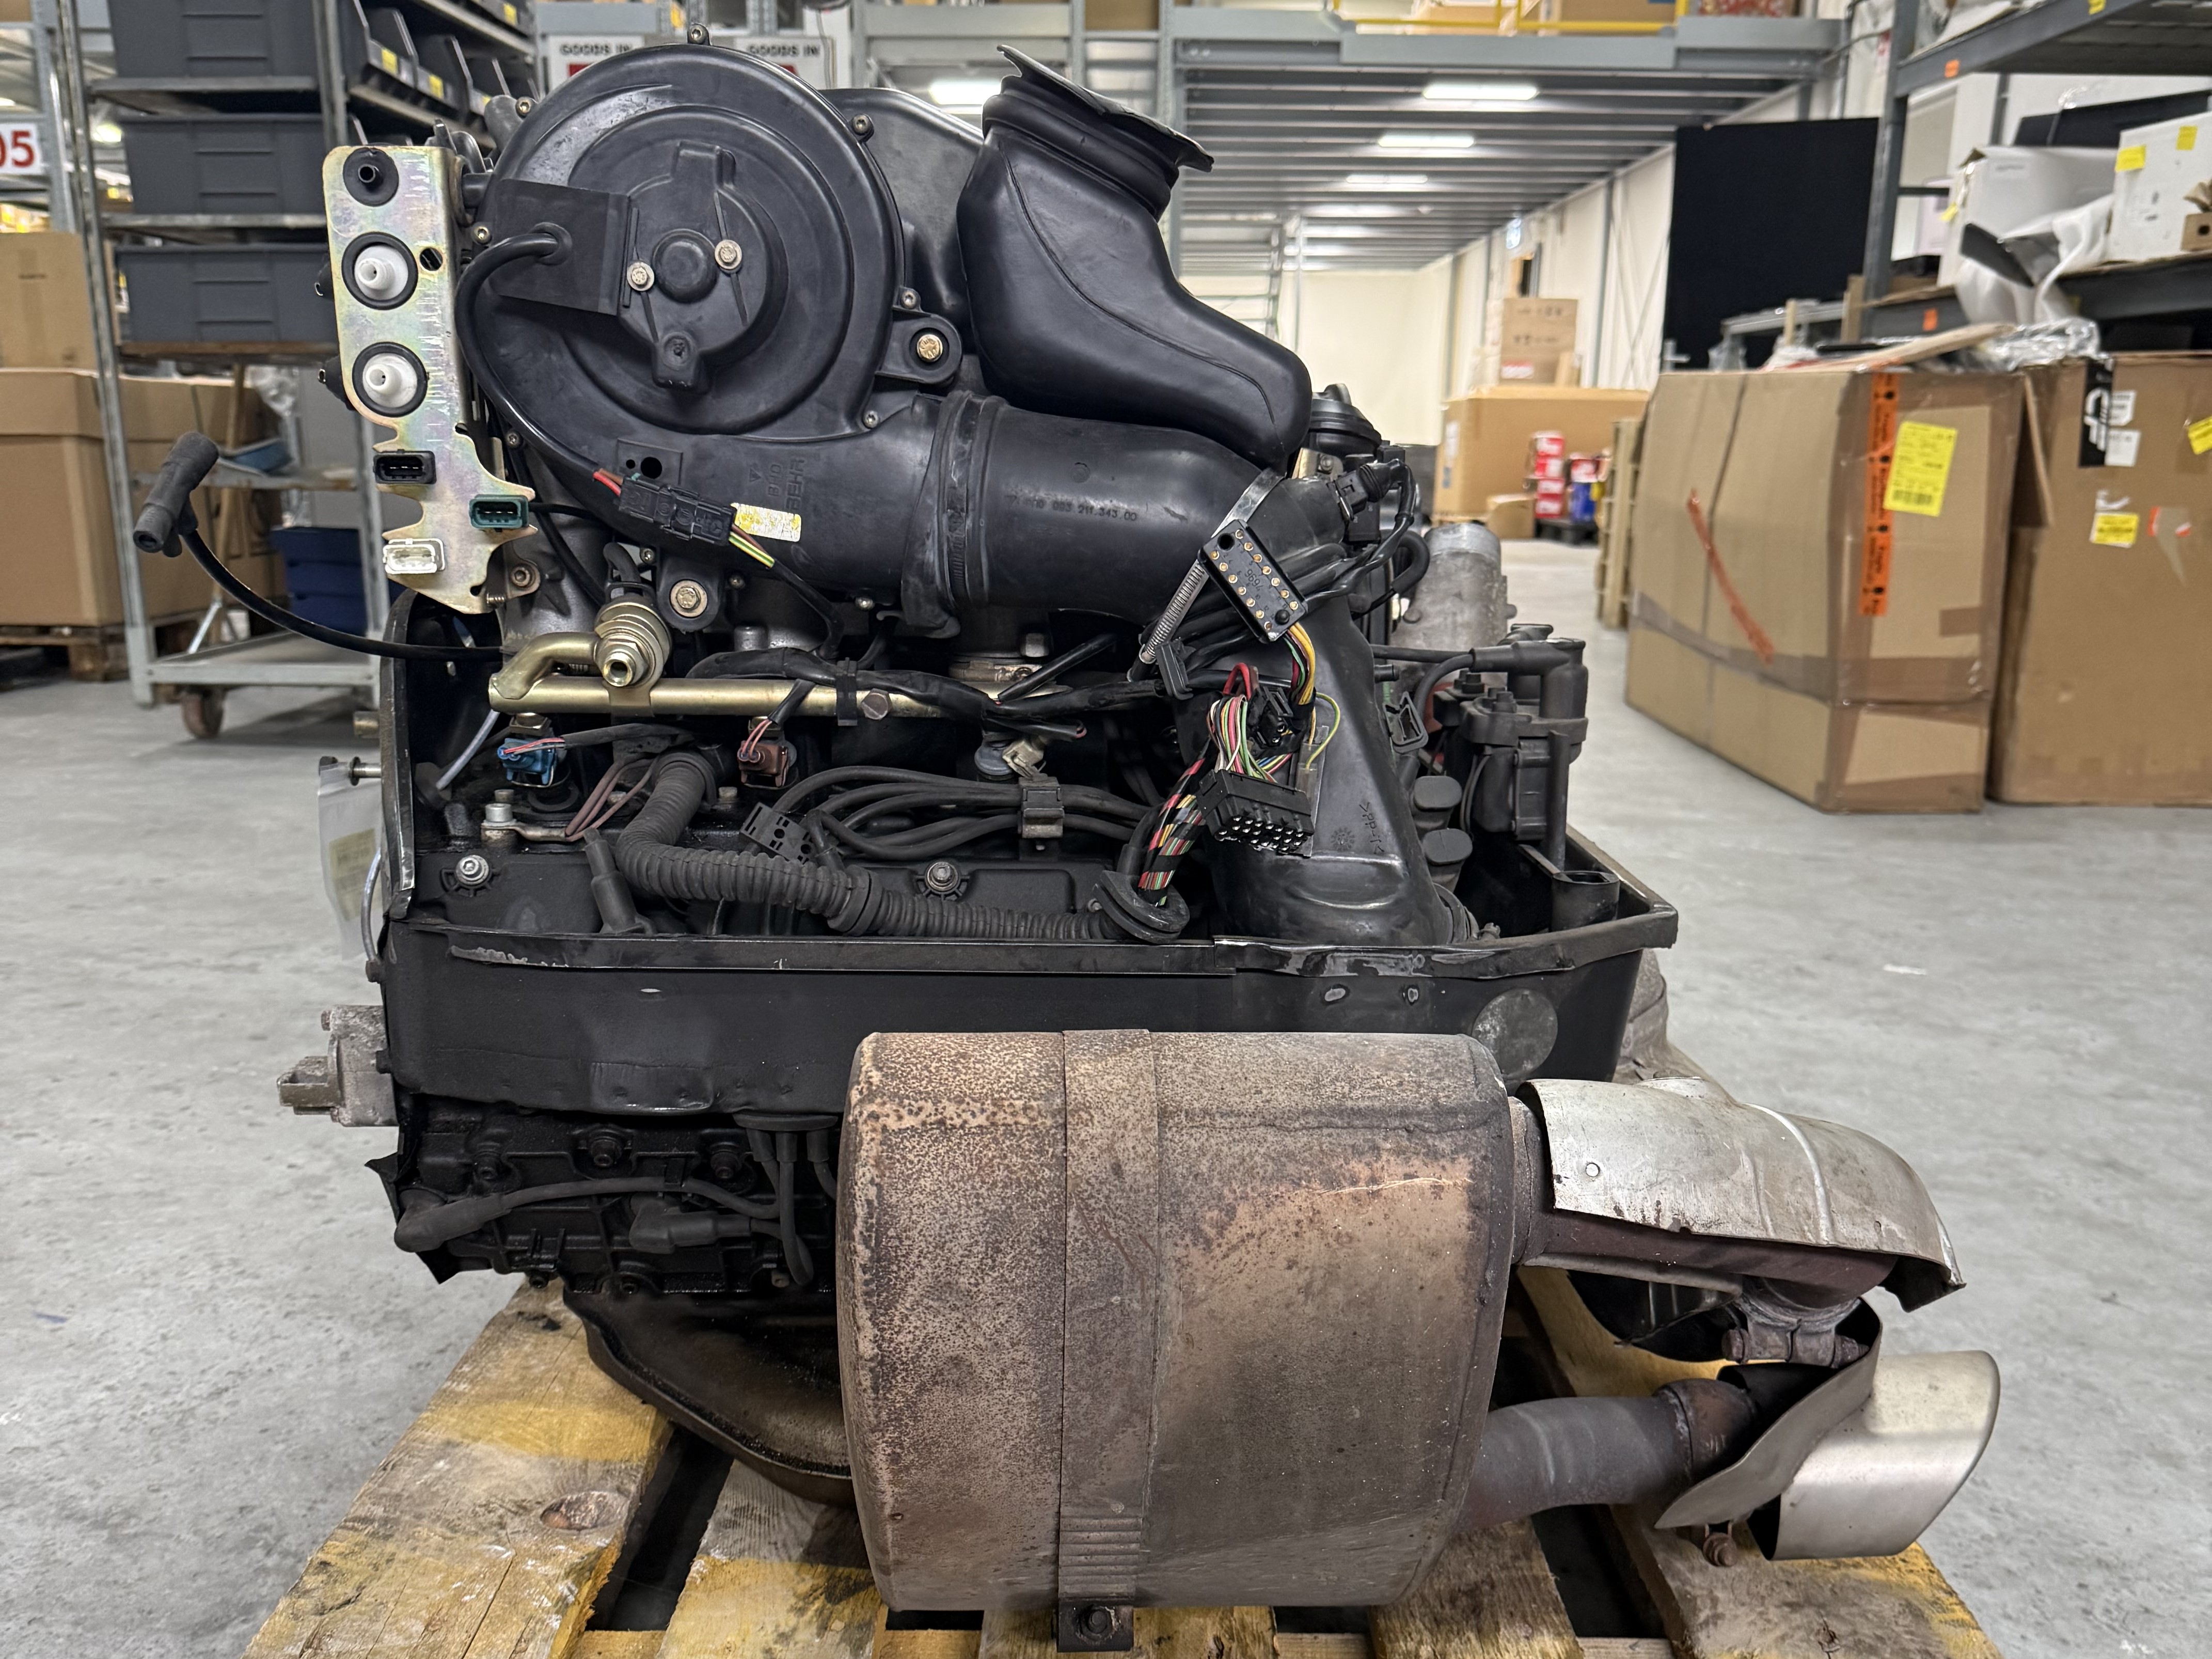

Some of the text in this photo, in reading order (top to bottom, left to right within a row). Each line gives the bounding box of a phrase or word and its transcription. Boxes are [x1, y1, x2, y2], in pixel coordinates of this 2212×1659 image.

[560, 43, 610, 56] GOODS
[748, 44, 799, 56] GOODS
[785, 458, 805, 510] BEHR
[1245, 569, 1263, 591] 9694
